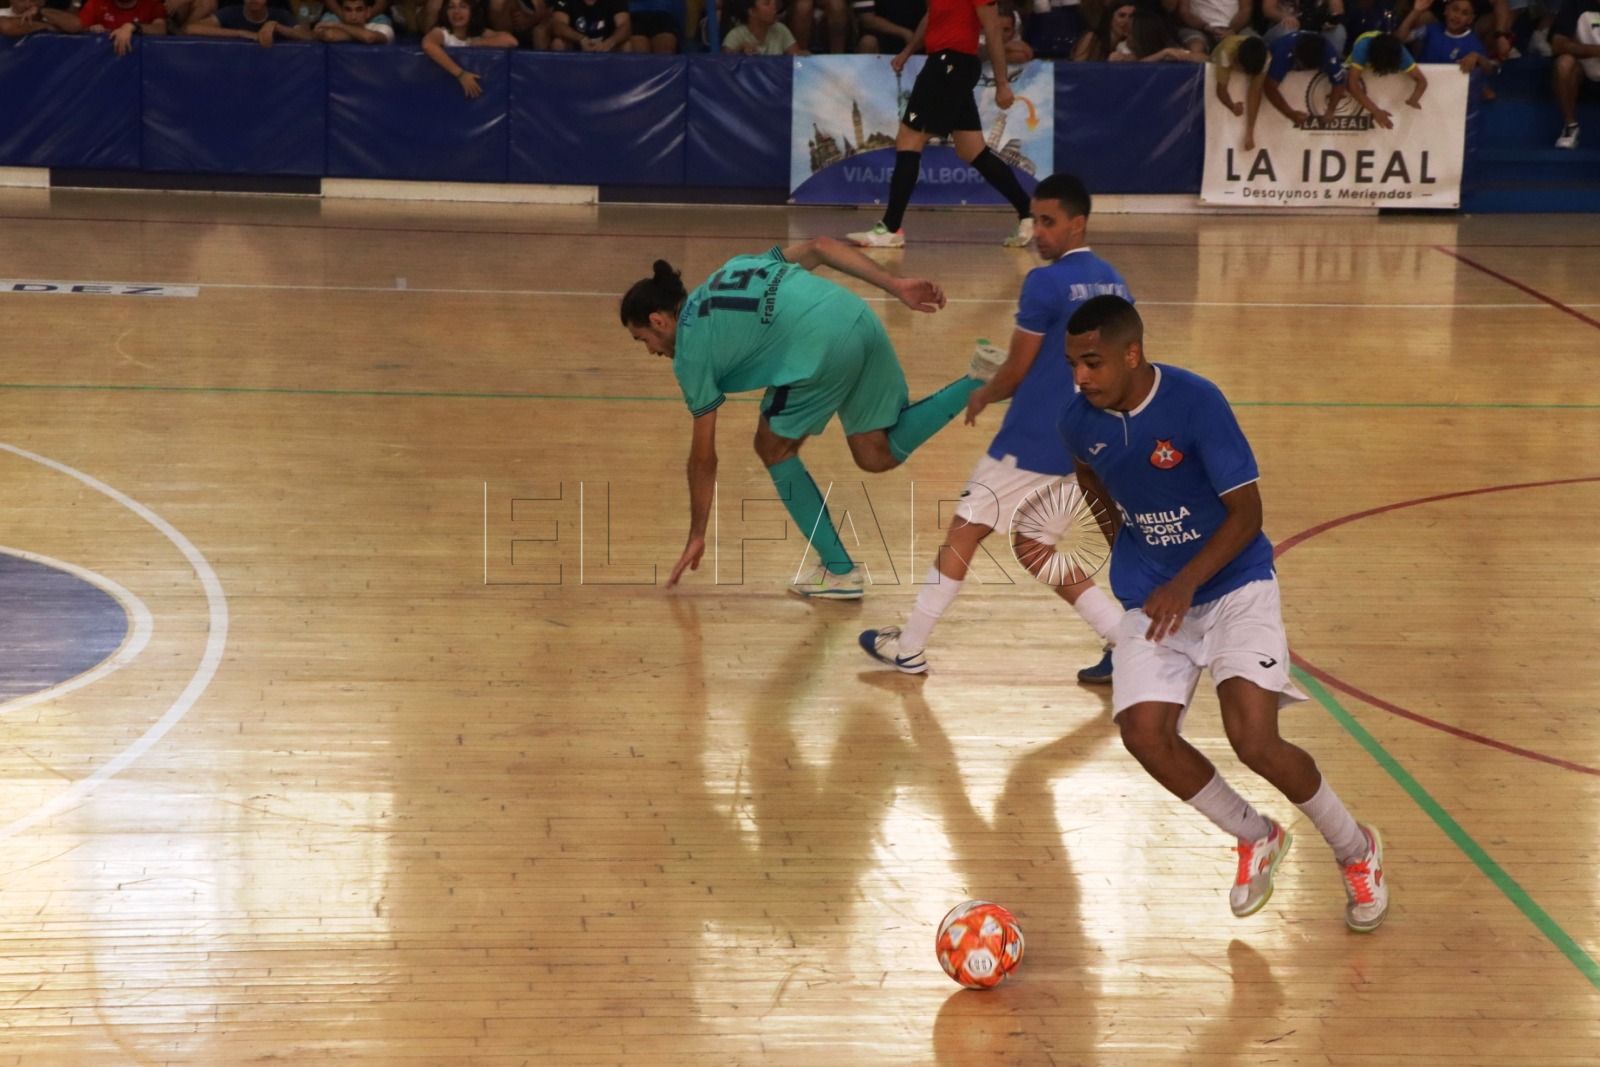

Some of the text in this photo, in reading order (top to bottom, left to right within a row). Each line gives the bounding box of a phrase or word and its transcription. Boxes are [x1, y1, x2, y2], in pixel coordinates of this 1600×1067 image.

[843, 166, 984, 184] VIAJE ALBOR
[1226, 148, 1436, 184] LA IDEAL
[1242, 187, 1412, 200] Desayunos & Meriendas
[1135, 506, 1192, 524] MELILLA
